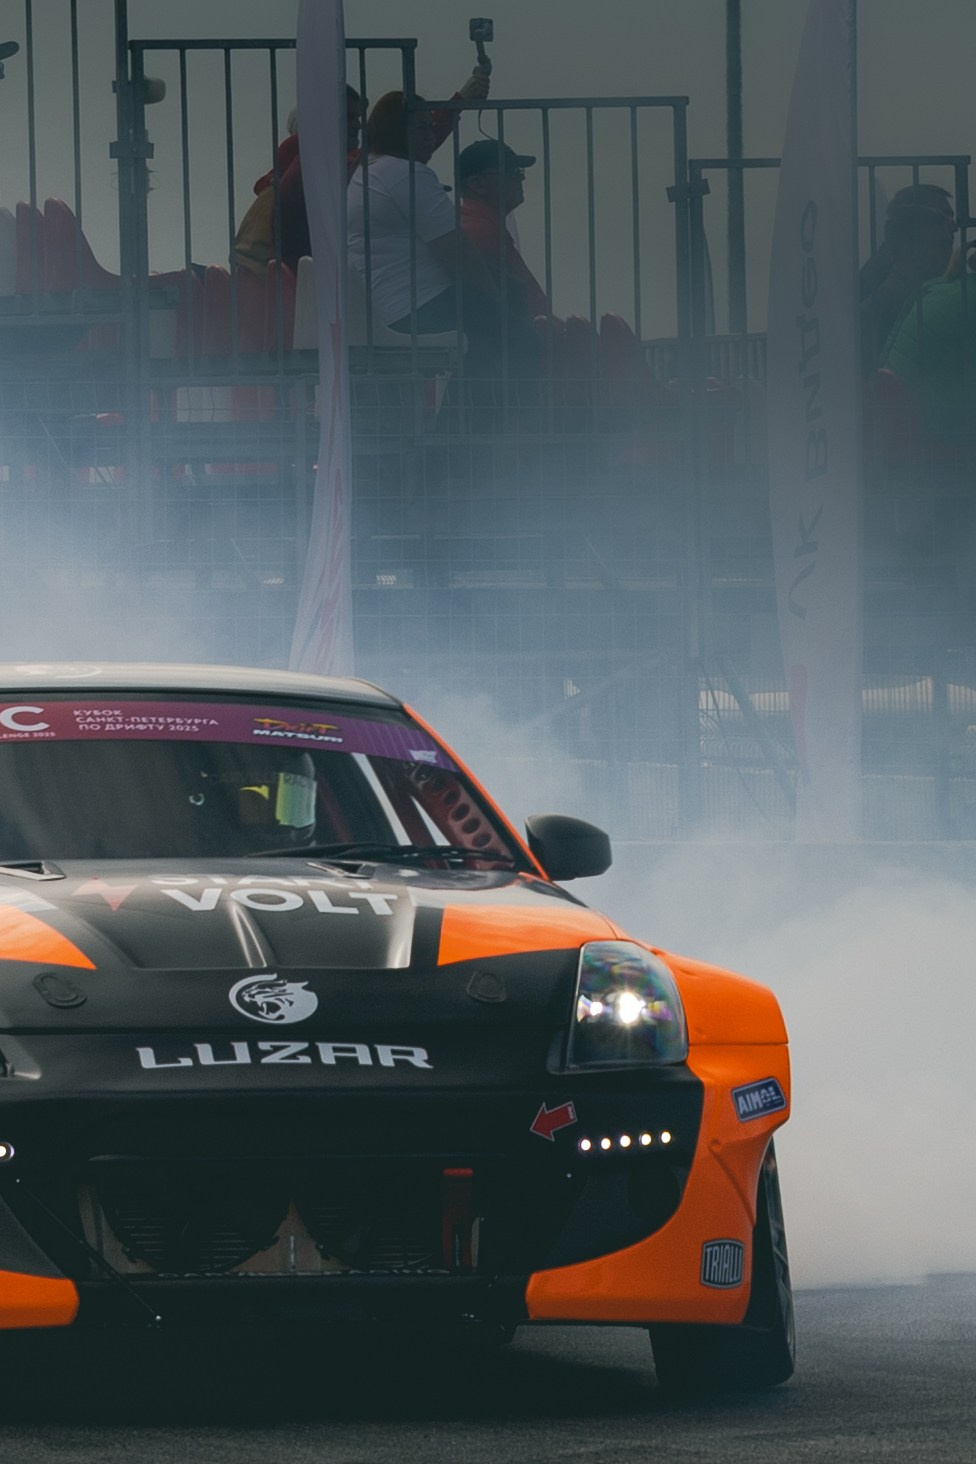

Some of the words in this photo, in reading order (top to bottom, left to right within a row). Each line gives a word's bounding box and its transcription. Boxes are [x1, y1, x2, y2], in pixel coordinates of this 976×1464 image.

[76, 716, 220, 726] САНКТ-ПЕТЕРБУРГА
[78, 723, 101, 731] ПО
[104, 723, 166, 732] ДРИФТУ
[168, 724, 200, 732] 2025
[32, 730, 56, 738] 2025
[252, 728, 344, 743] MATSURI
[148, 873, 374, 890] START
[160, 888, 399, 916] VOLT
[135, 1040, 434, 1071] LUZAR
[737, 1085, 782, 1115] AIMOL
[704, 1244, 744, 1284] TRIALLI
